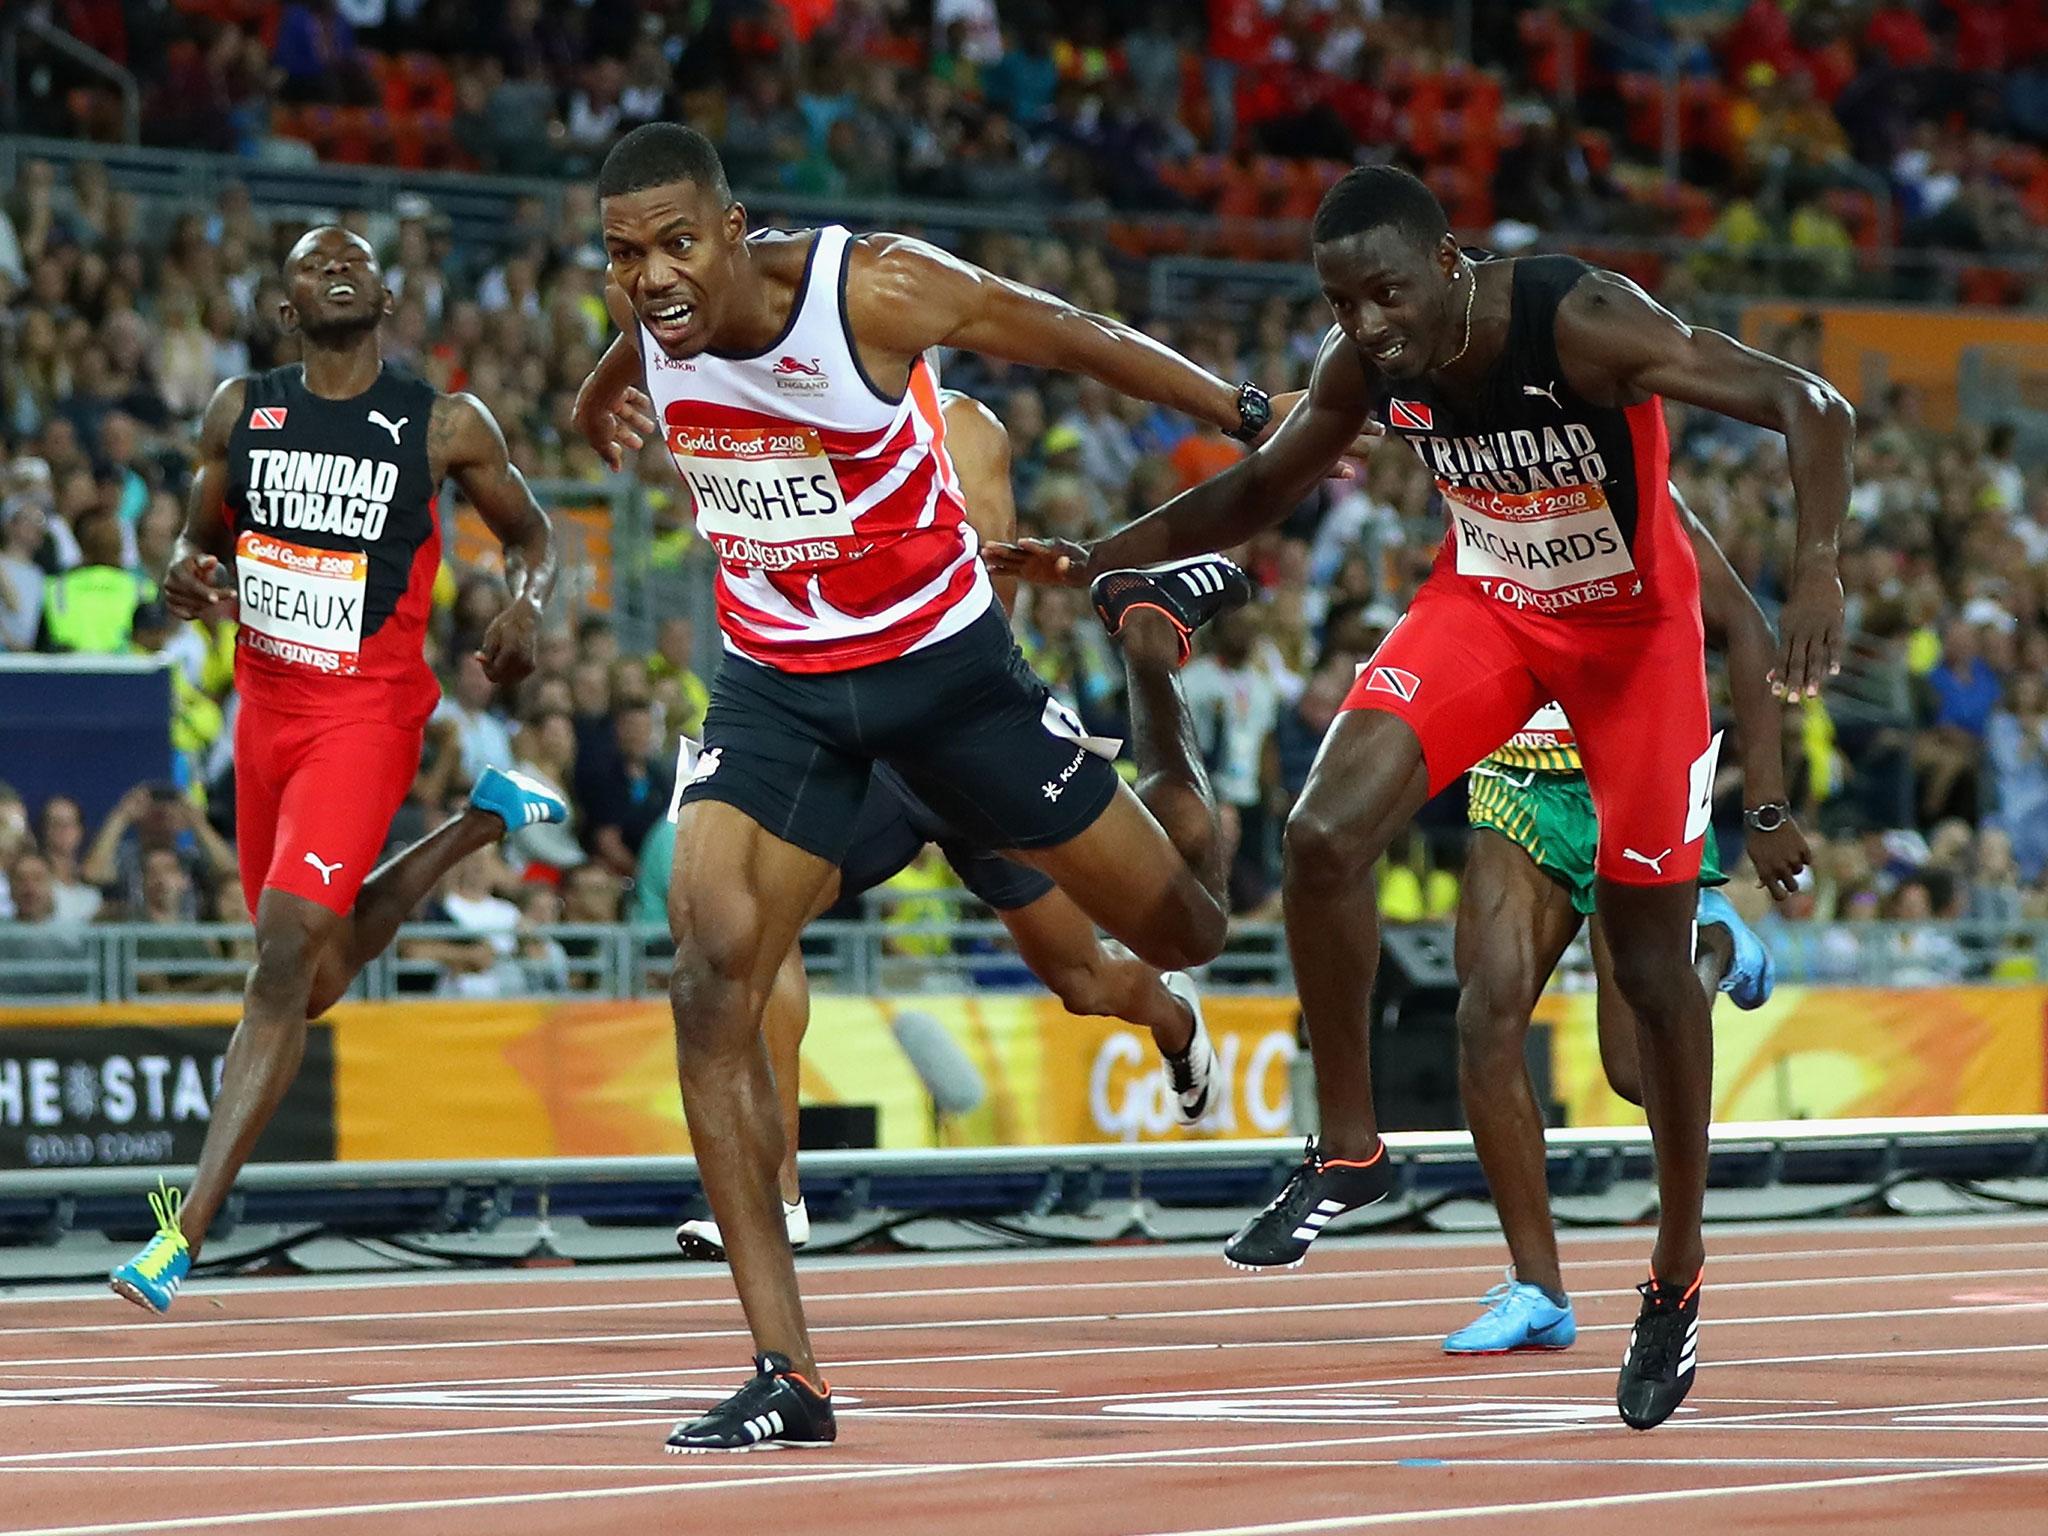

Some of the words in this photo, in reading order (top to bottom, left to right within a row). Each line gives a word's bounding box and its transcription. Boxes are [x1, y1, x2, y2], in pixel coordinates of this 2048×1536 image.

[777, 381, 829, 390] ENGLAND
[677, 432, 716, 452] Gold
[719, 435, 765, 453] Coast
[769, 436, 806, 451] 2018
[1405, 424, 1596, 474] TRINIDAD
[249, 449, 399, 503] TRINIDAD
[689, 472, 838, 520] HUGHES
[246, 490, 388, 541] &TOBAGO
[1491, 497, 1541, 515] Coast
[1545, 492, 1587, 512] 2018
[247, 538, 279, 560] Gold
[280, 548, 319, 569] Coast
[319, 556, 354, 574] 2018
[718, 538, 839, 566] LONGINES
[1460, 518, 1618, 570] RICHARDS
[244, 575, 357, 632] GREAUX
[1480, 580, 1619, 610] LONGINES
[249, 631, 340, 670] LONGINES
[0, 1057, 62, 1126] HE
[101, 1054, 225, 1124] STA
